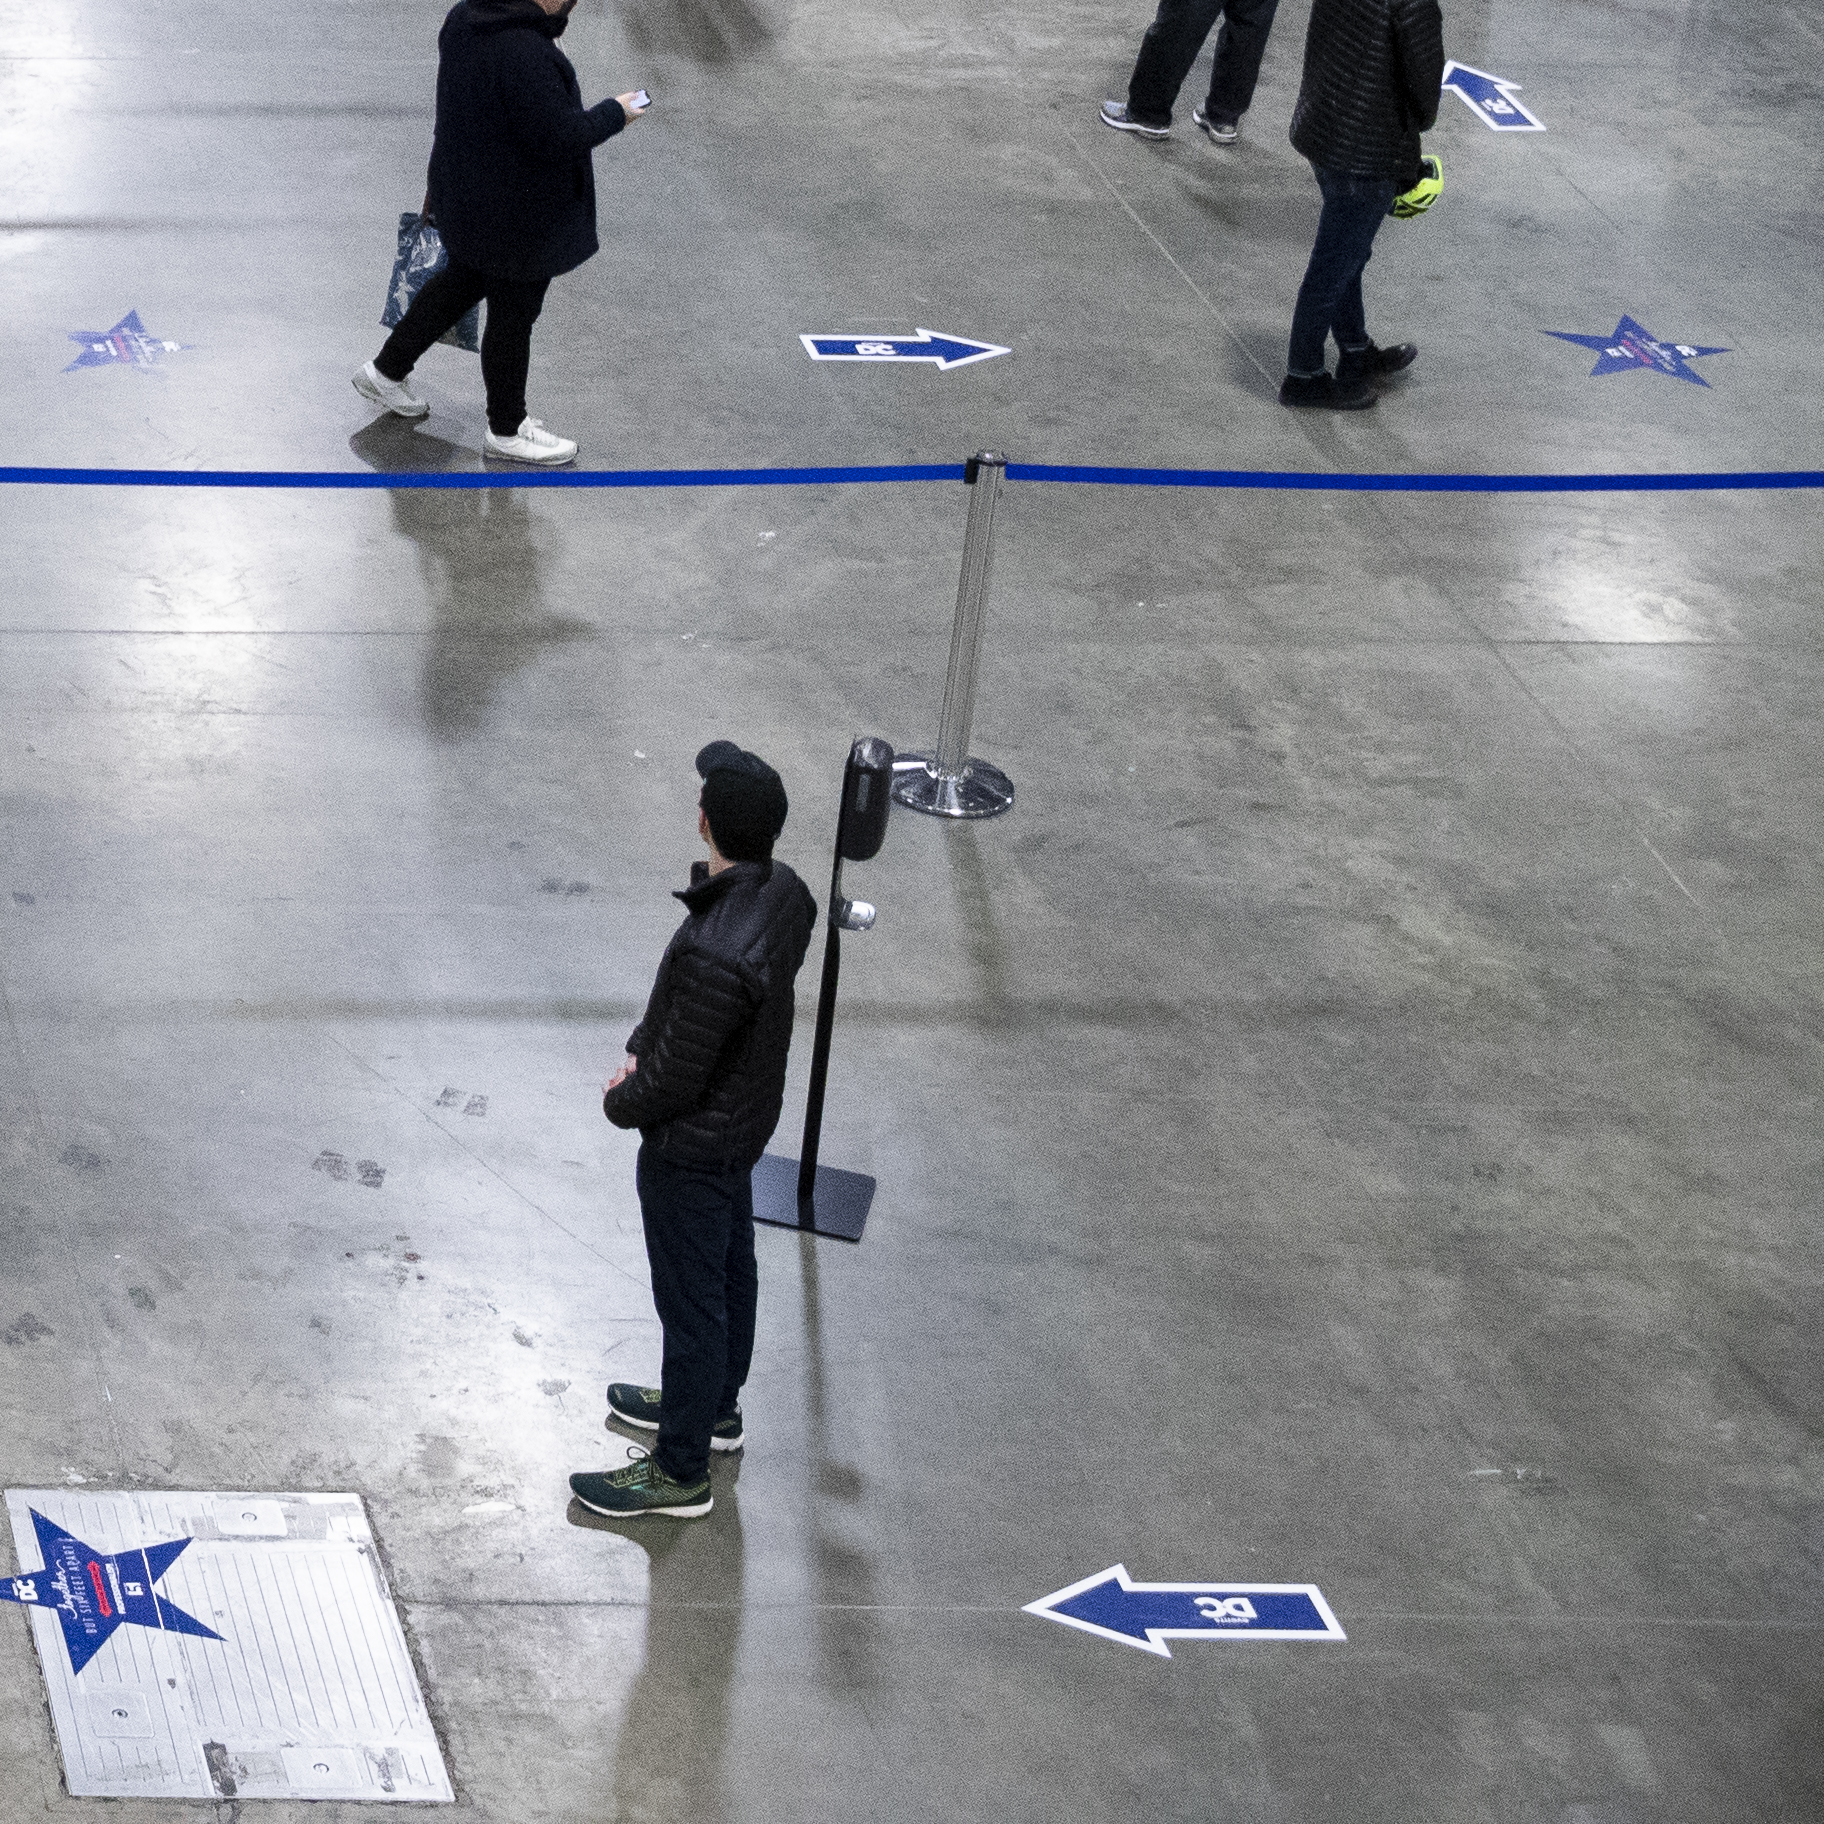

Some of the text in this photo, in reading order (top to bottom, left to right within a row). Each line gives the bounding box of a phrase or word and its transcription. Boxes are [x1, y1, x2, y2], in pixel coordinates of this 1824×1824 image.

[855, 344, 896, 356] DC
[62, 1544, 81, 1573] APART
[17, 1578, 39, 1601] DC
[70, 1576, 87, 1597] FEET
[1193, 1596, 1259, 1619] DC
[82, 1617, 98, 1635] BUT
